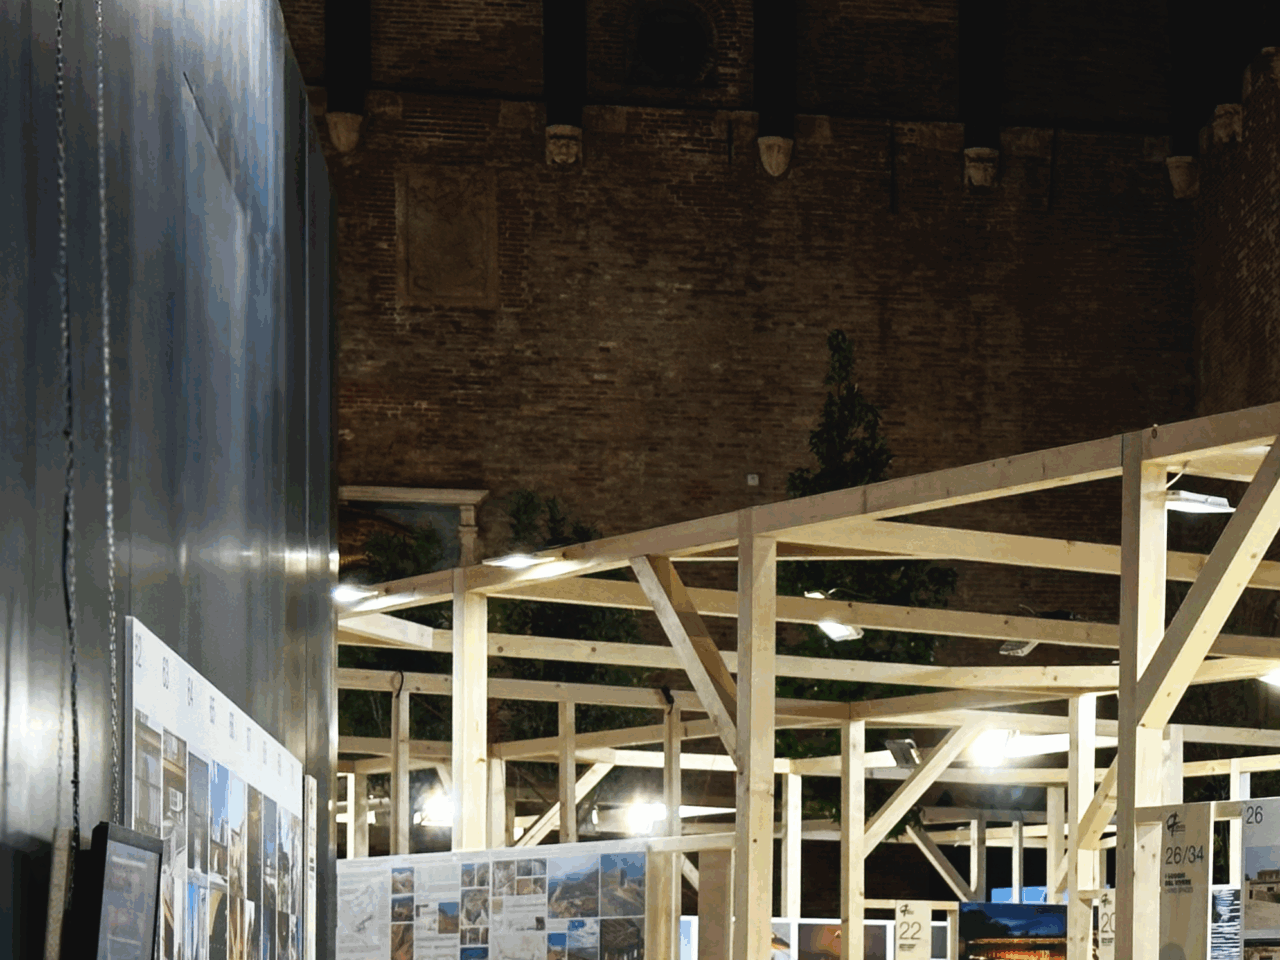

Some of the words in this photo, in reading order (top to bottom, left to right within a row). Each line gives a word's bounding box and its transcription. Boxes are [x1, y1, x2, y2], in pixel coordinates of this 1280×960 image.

[1245, 805, 1263, 825] 26
[1165, 845, 1204, 865] 26/34
[899, 921, 922, 940] 22
